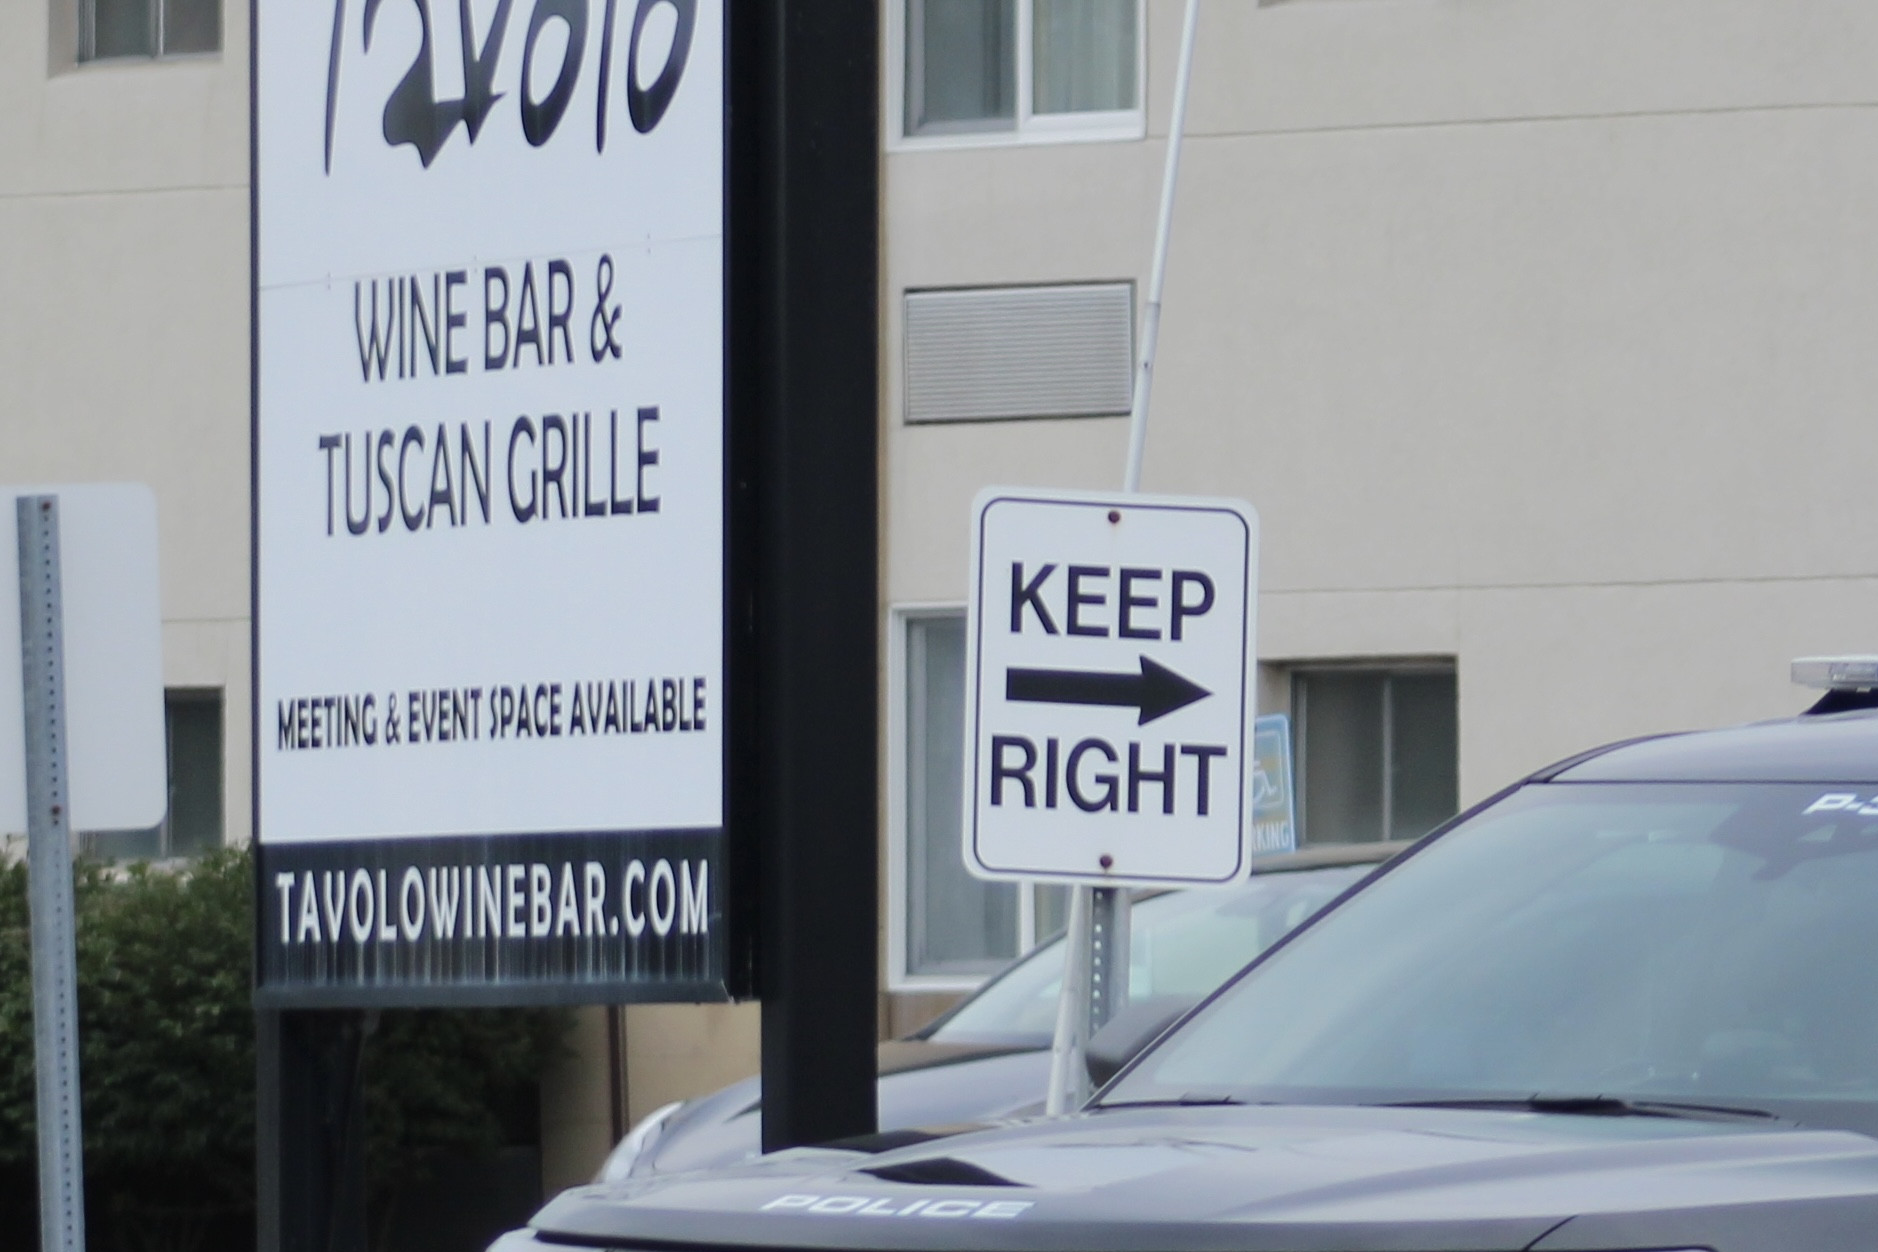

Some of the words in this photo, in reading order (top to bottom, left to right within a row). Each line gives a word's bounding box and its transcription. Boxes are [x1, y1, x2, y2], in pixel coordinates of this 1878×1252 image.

[354, 269, 468, 383] WINE
[484, 258, 576, 373] BAR
[590, 253, 623, 365] &
[319, 419, 492, 537] TUSCAN
[507, 405, 661, 524] GRILLE
[1010, 561, 1217, 642] KEEP
[277, 692, 378, 751] MEETING
[385, 692, 401, 744] &
[408, 687, 482, 742] EVENT
[489, 682, 563, 739] SPACE
[569, 676, 707, 737] AVAILABLE
[990, 734, 1228, 817] RIGHT
[275, 857, 710, 945] TAVOLOWINEBAR.COM
[760, 1194, 1036, 1218] POLICE
